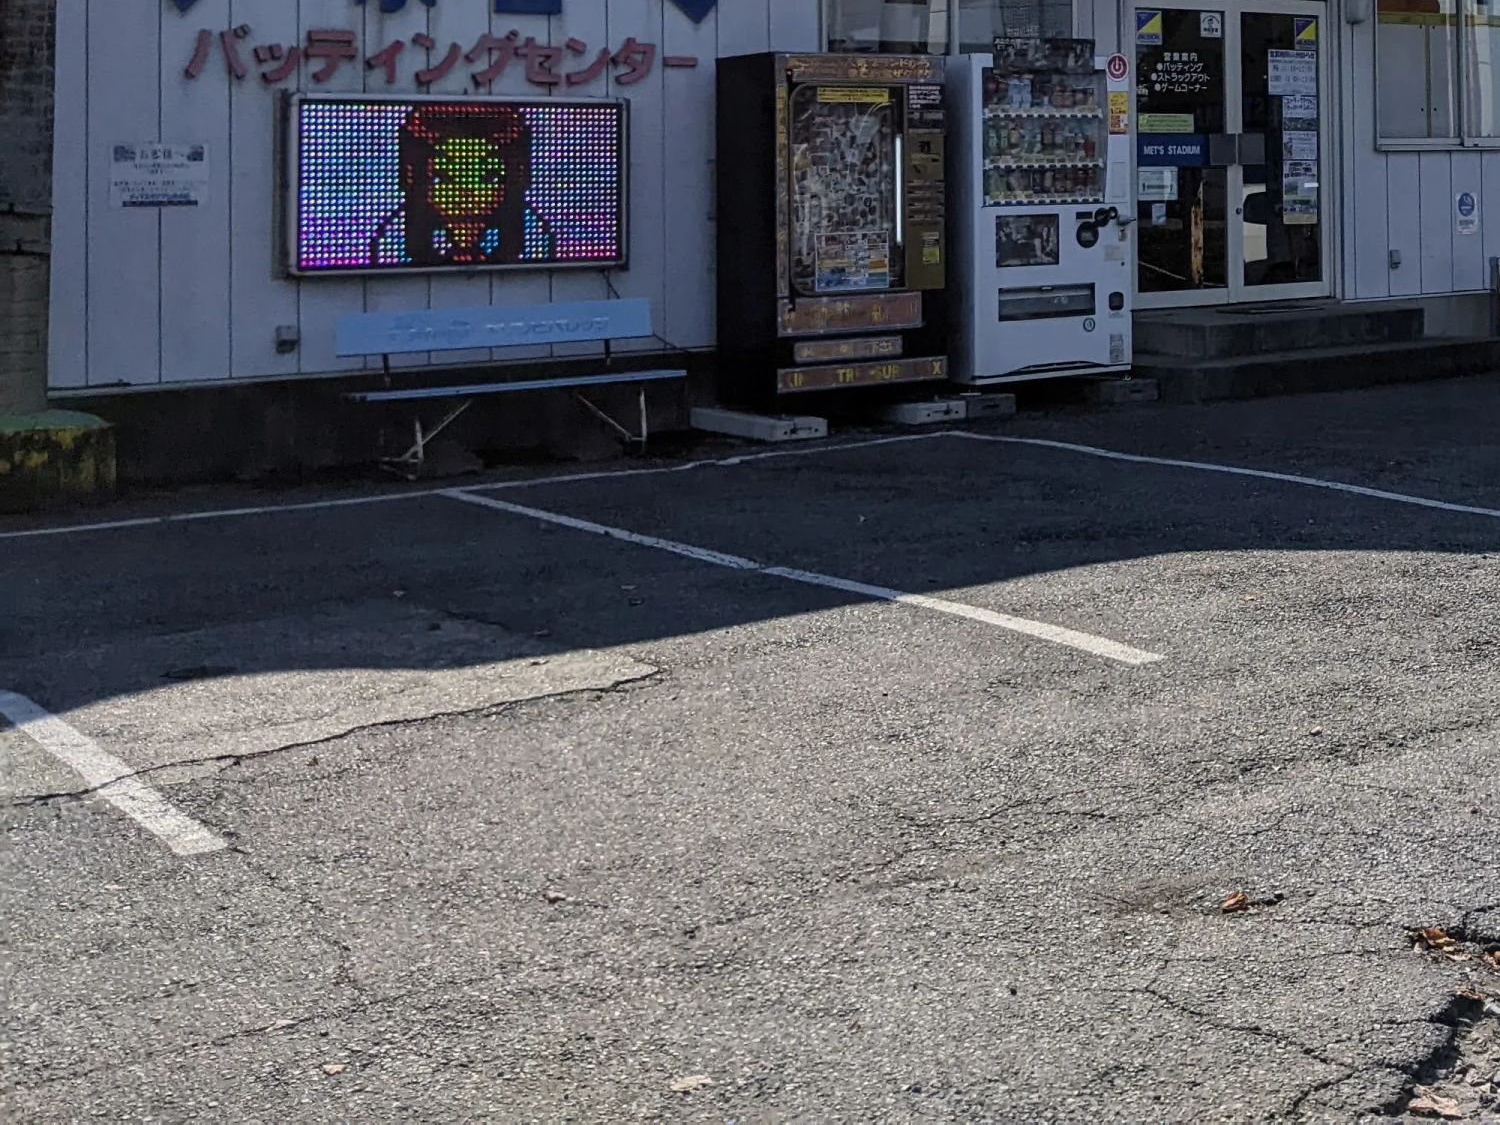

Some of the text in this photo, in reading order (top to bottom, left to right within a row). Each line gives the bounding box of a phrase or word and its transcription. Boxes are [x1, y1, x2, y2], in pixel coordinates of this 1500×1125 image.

[184, 23, 698, 87] バッティングセンター
[1167, 145, 1201, 155] STADIUM
